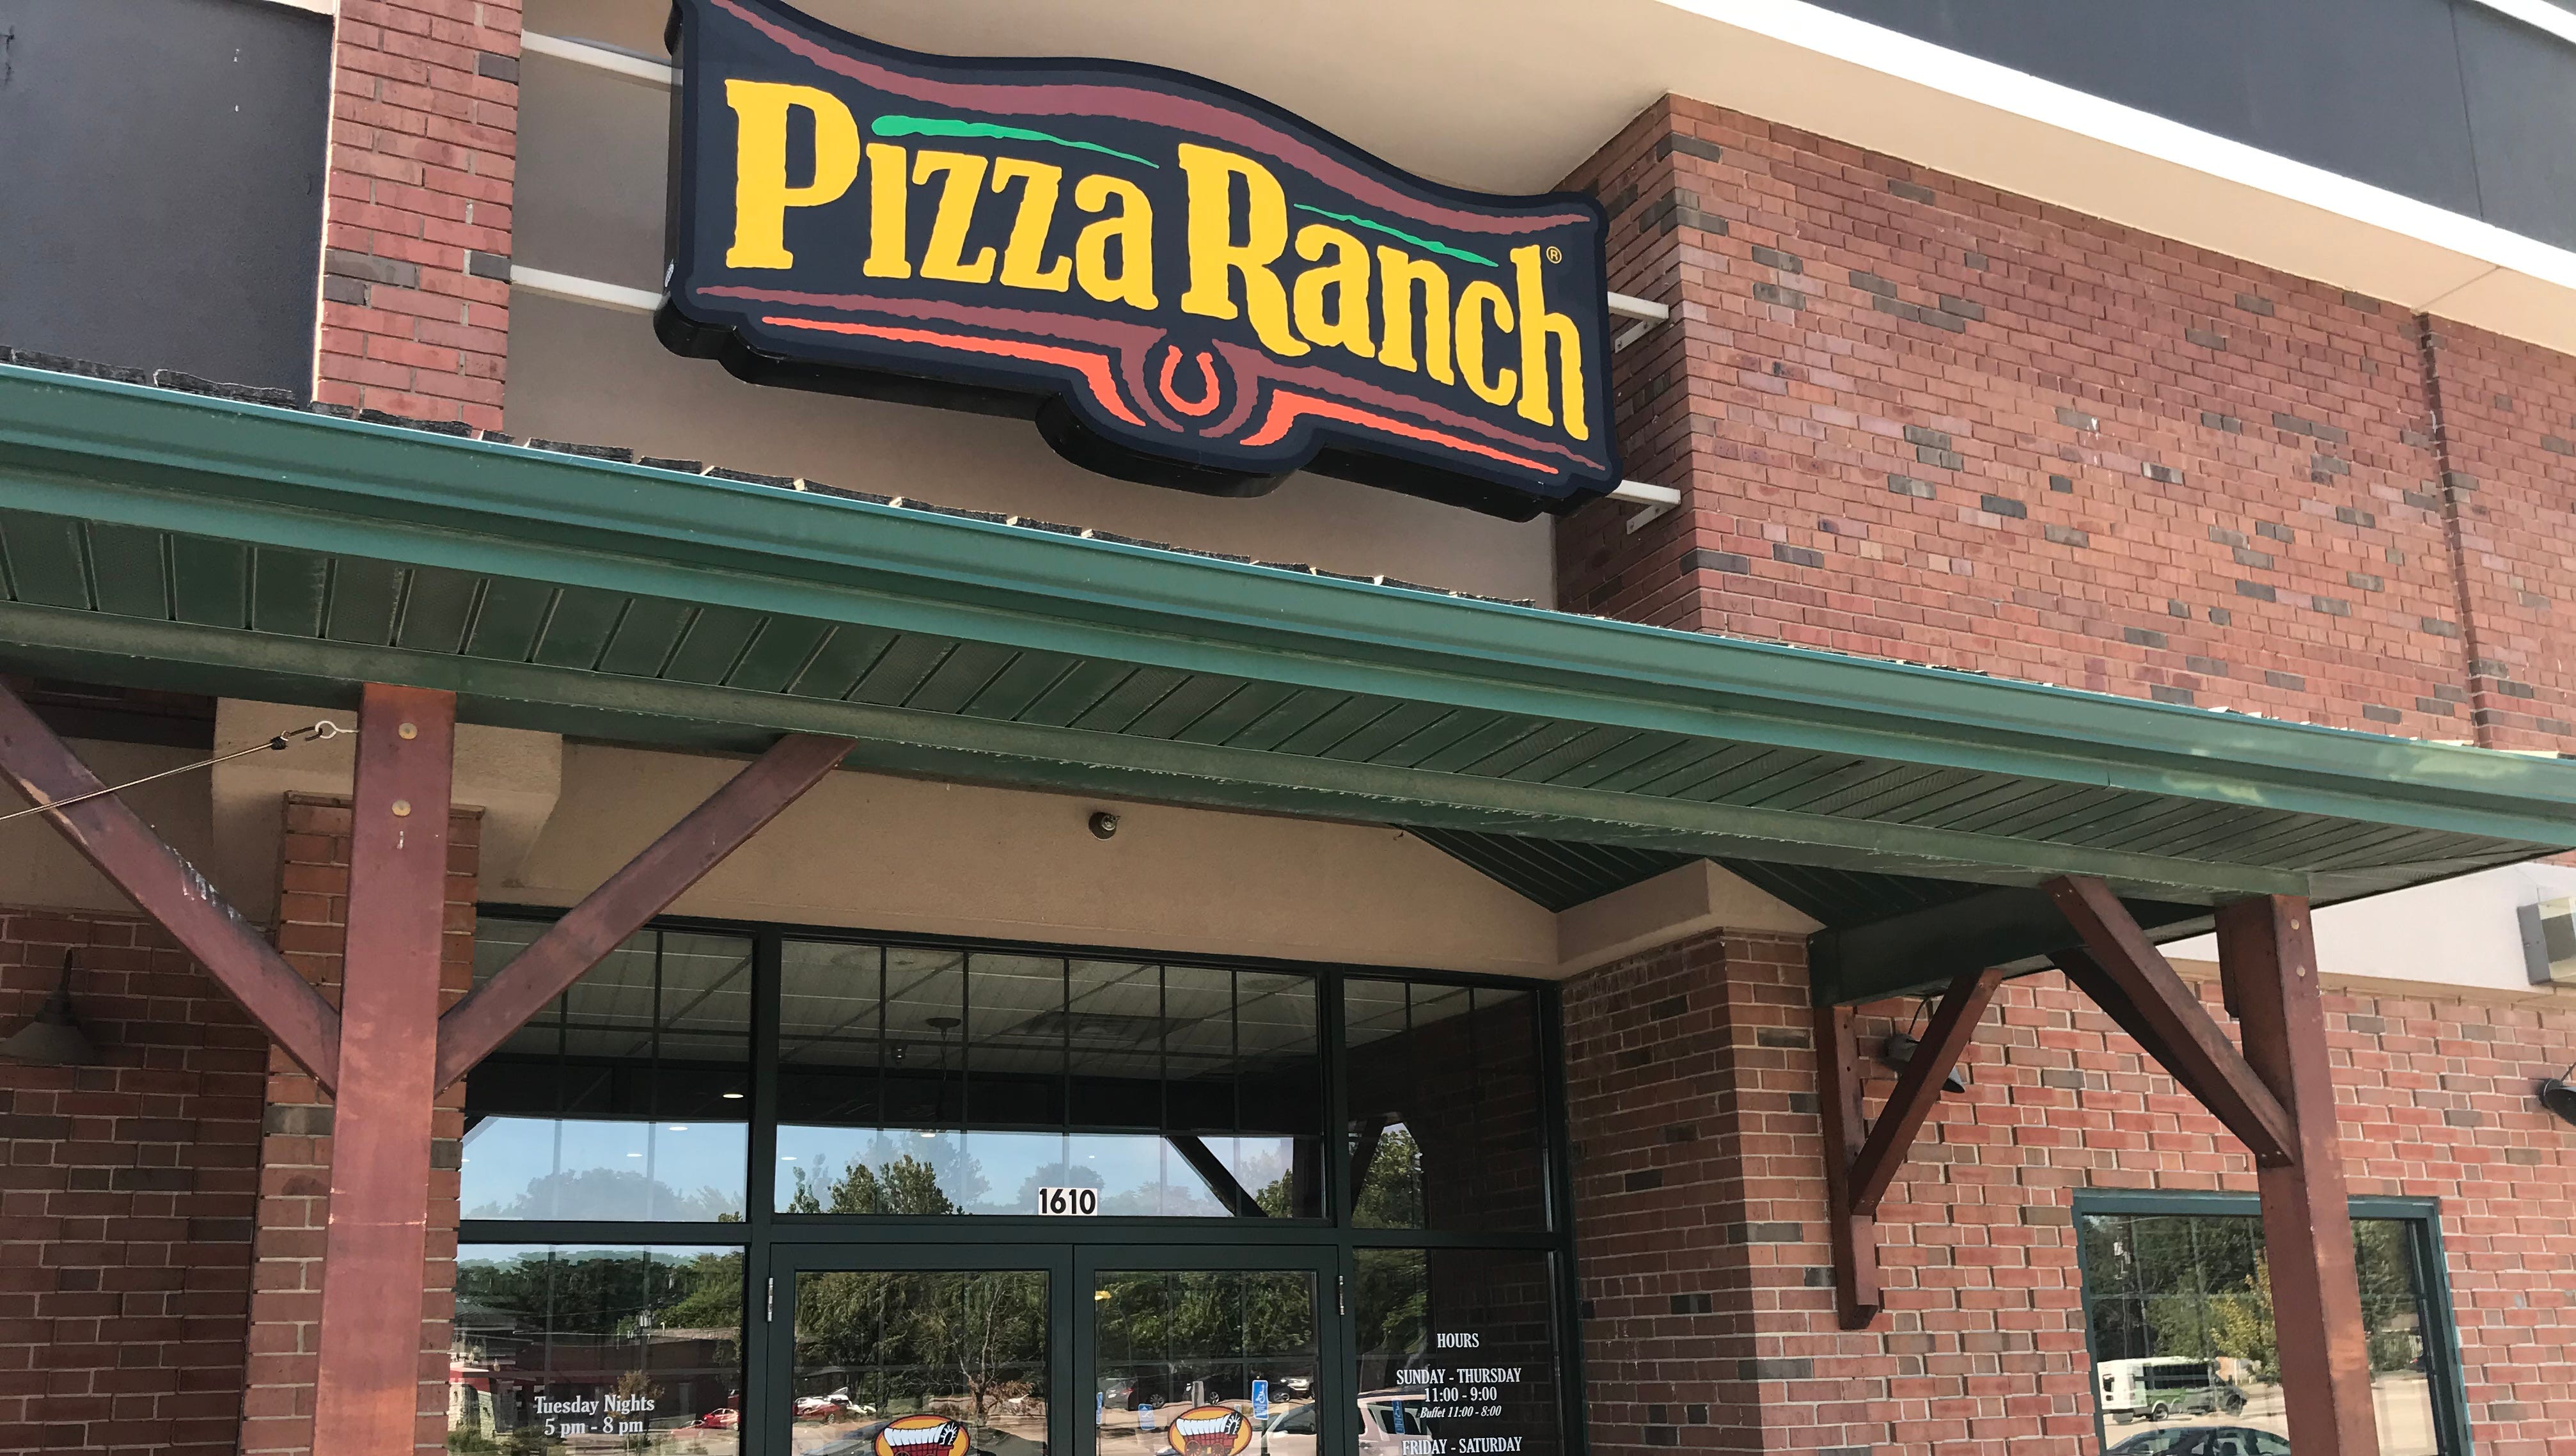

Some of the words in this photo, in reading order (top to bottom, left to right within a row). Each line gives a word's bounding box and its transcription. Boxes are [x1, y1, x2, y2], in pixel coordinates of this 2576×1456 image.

[725, 79, 1158, 311] Pizza
[1178, 142, 1589, 440] Ranch
[1039, 1188, 1096, 1215] 1610
[1436, 1333, 1480, 1349] HOURS
[1396, 1368, 1446, 1385] SUNDAY
[1456, 1368, 1522, 1384] THURSDAY
[1424, 1387, 1459, 1402] 11:00
[1470, 1386, 1498, 1402] 9:00
[534, 1395, 600, 1416] Tuesday
[604, 1393, 656, 1415] Nights
[1420, 1406, 1446, 1418] Buffet
[1447, 1406, 1474, 1418] 11:00
[1480, 1405, 1502, 1417] 8:00
[544, 1417, 555, 1436] 5
[560, 1423, 586, 1438] pm
[602, 1416, 614, 1434] 8
[618, 1420, 643, 1437] pm
[1402, 1439, 1448, 1456] FRIDAY
[1459, 1436, 1523, 1453] SATURDAY
